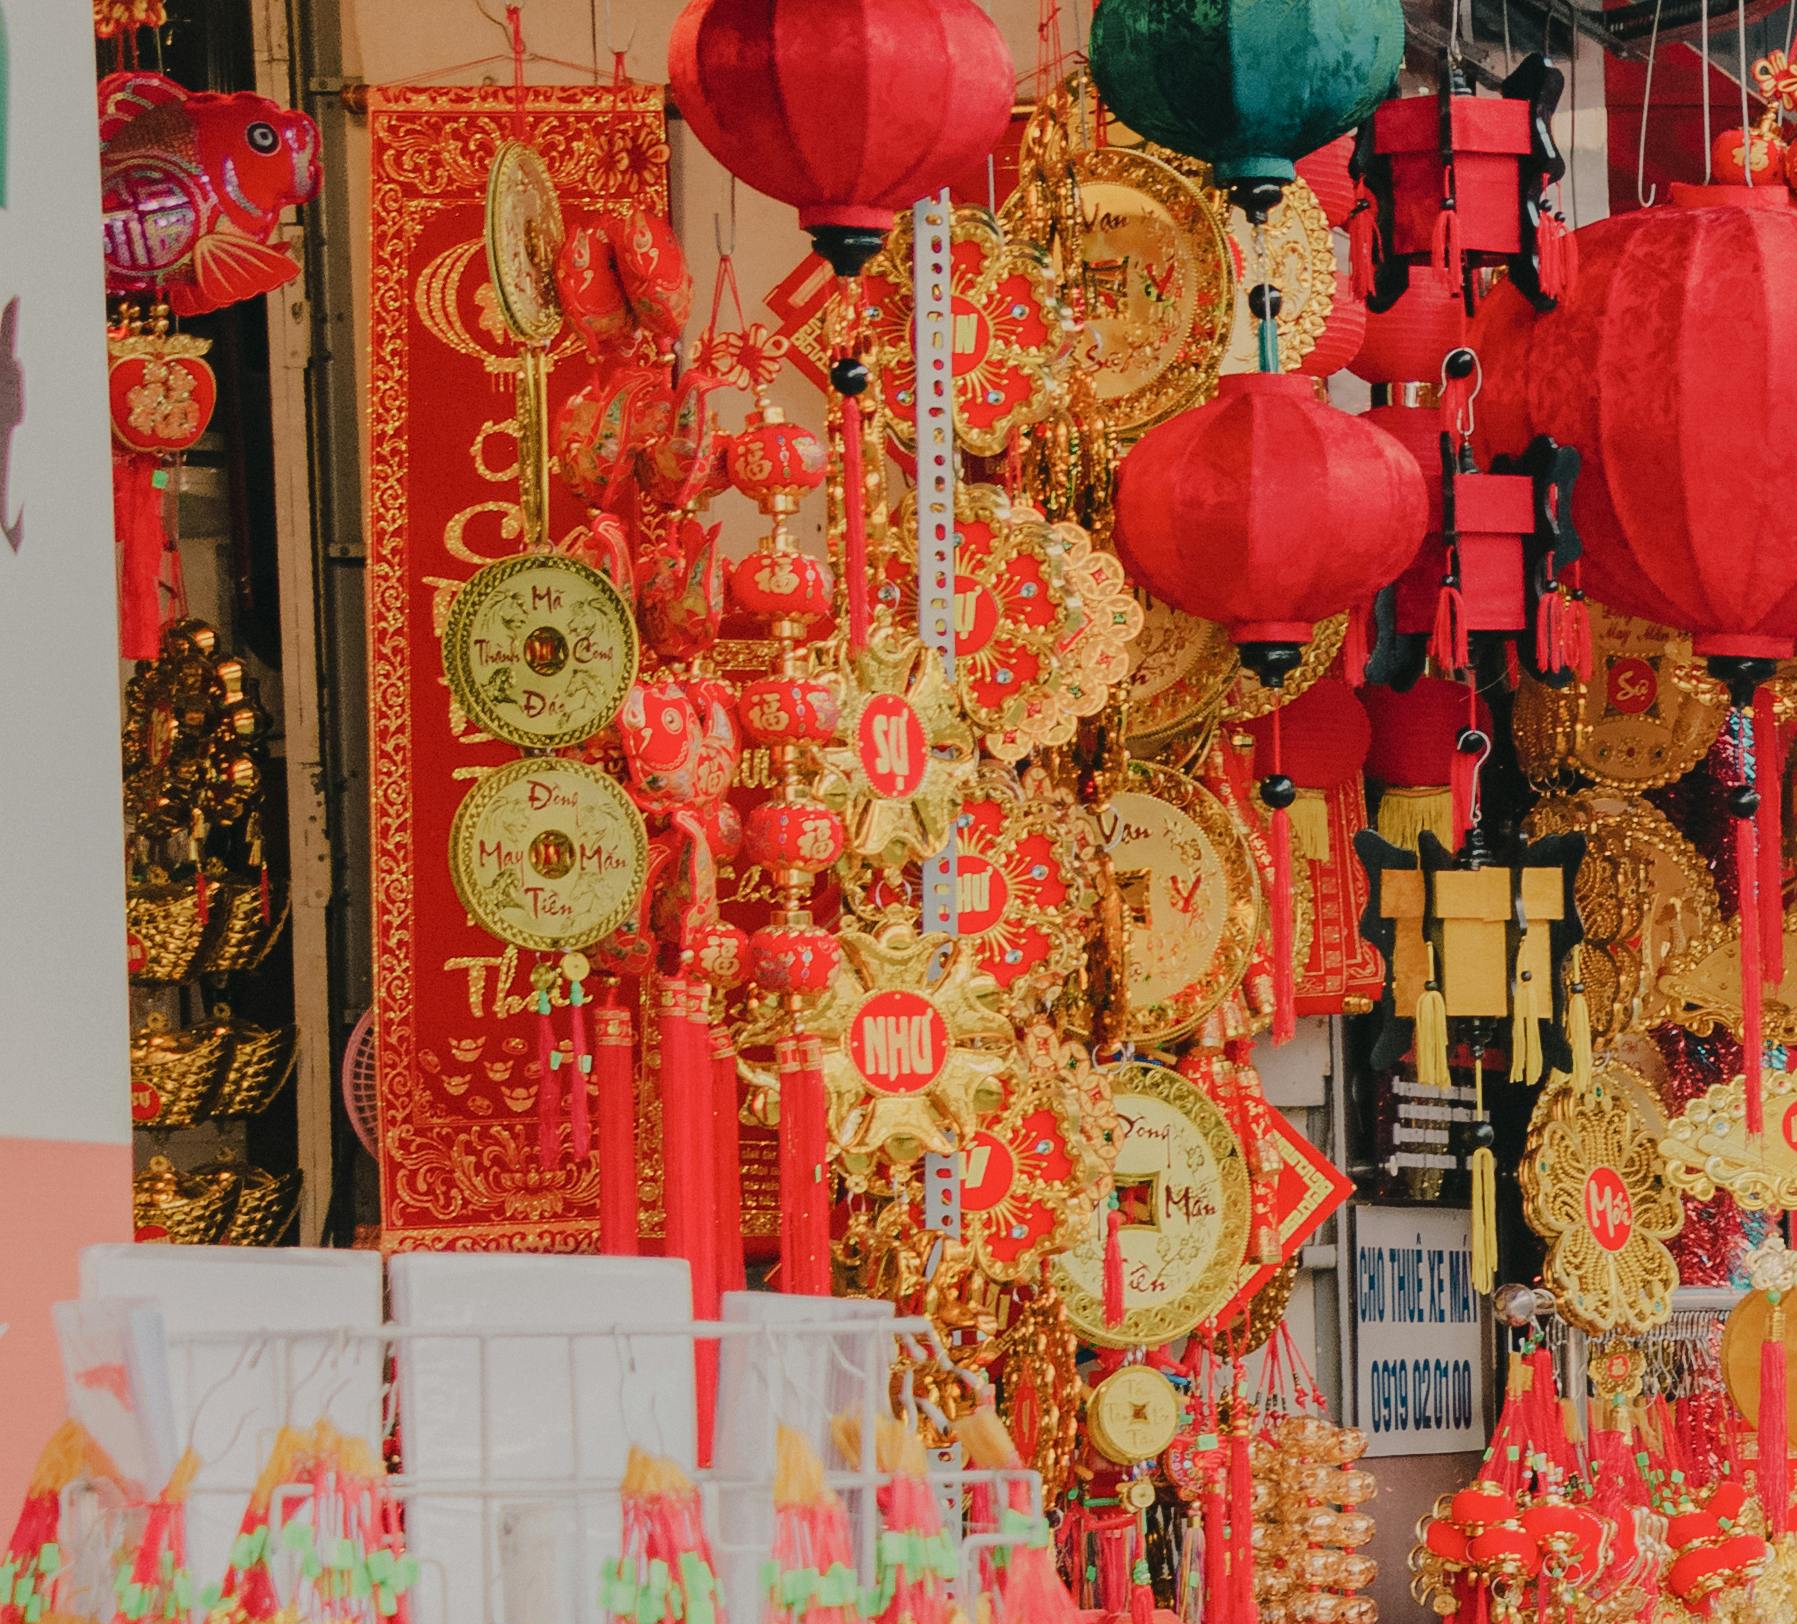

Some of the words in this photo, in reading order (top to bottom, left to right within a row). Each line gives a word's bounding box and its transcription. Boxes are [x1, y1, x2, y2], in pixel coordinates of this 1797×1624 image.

[531, 585, 566, 614] Mã
[873, 706, 910, 791] SỰ
[479, 839, 525, 888] May
[579, 841, 628, 873] Mắn
[957, 862, 991, 914] HƯ
[862, 1004, 936, 1083] NHƯ
[1164, 1184, 1217, 1225] Mắn
[1359, 1246, 1386, 1323] CHO
[1389, 1232, 1425, 1323] THUÊ
[1427, 1249, 1446, 1324] XE
[1371, 1358, 1409, 1434] 0919
